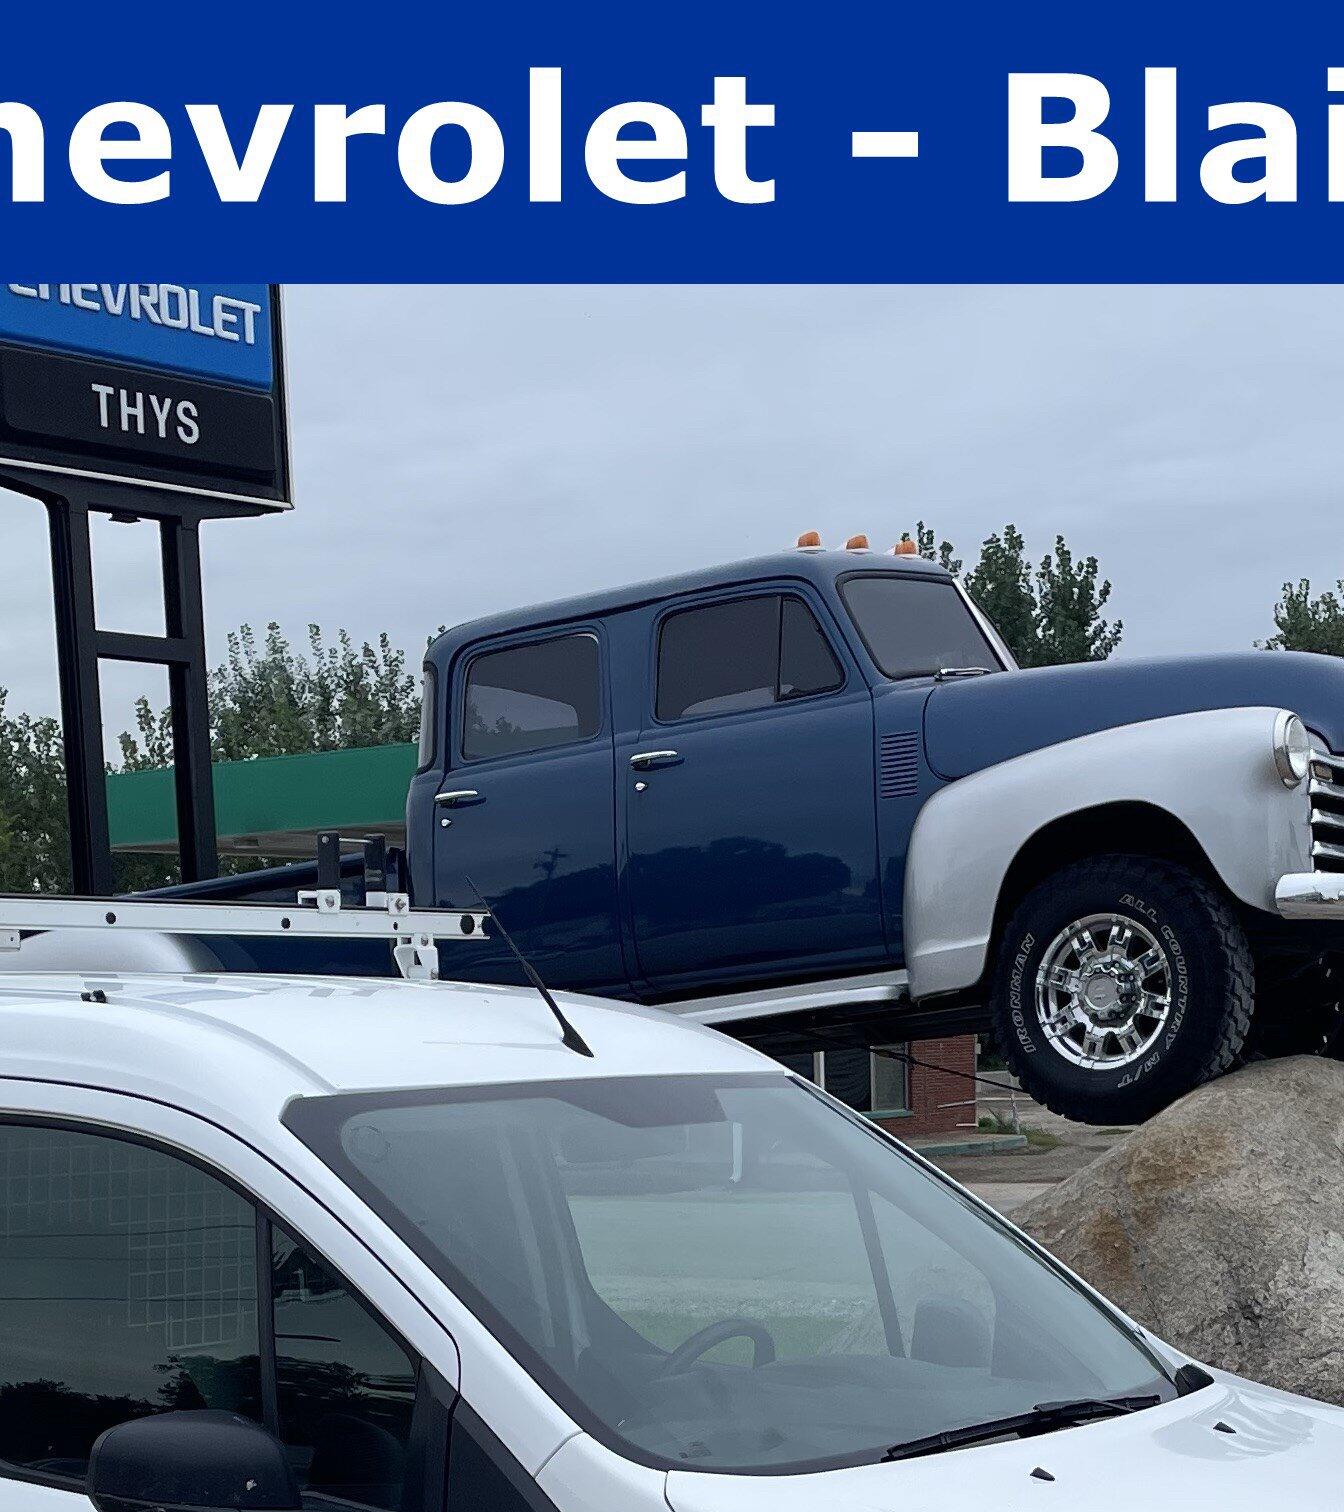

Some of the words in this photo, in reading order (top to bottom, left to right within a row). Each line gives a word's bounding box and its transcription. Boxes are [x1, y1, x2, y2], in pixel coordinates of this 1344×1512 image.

[91, 383, 200, 445] THYS
[1118, 893, 1158, 925] ALL
[1009, 933, 1037, 1054] IRONMAN
[1160, 924, 1188, 1051] COUNTRY
[1117, 1052, 1161, 1088] M/T
